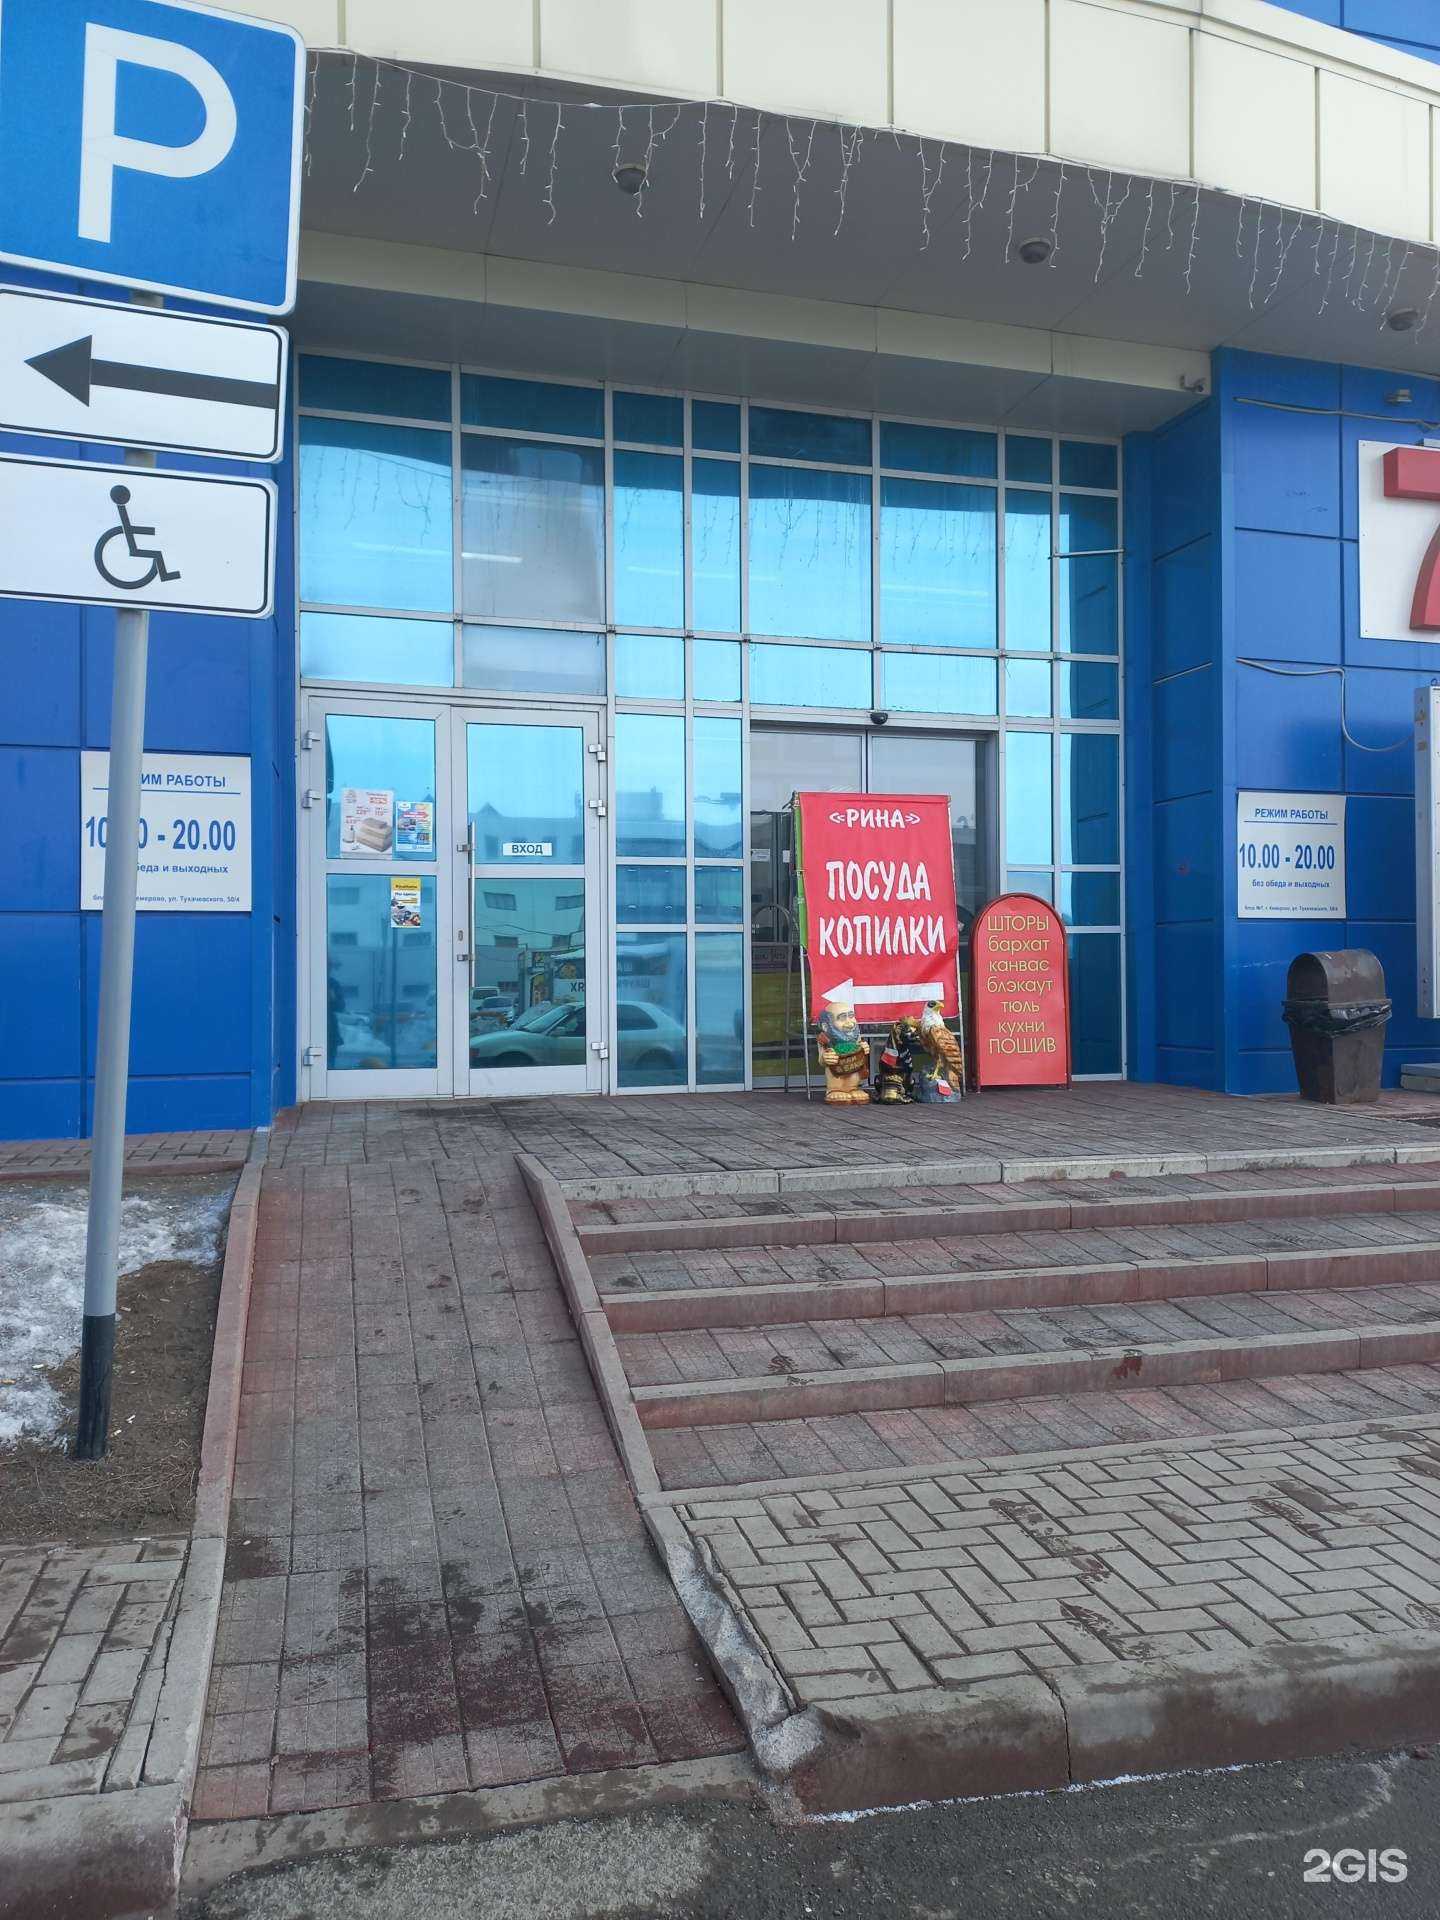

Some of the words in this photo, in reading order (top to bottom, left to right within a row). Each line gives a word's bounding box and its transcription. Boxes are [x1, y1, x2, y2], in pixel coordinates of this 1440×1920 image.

[78, 22, 237, 243] P
[166, 774, 226, 788] РАБОТЫ
[829, 808, 921, 829] «РИНА»
[1254, 808, 1288, 818] РЕЖИМ
[1290, 809, 1329, 820] РАБОТЫ
[172, 818, 236, 851] 20.00
[511, 844, 543, 855] ВХОД
[1239, 843, 1280, 869] 10.00
[1295, 844, 1335, 870] 20.00
[162, 864, 169, 873] и
[172, 864, 228, 875] выходных
[825, 860, 932, 901] ПОСУДА
[1252, 878, 1264, 888] без
[1265, 879, 1287, 888] обеда
[987, 915, 1049, 932] ШТОРЫ
[819, 915, 946, 958] КОПИЛКИ
[988, 935, 1050, 955] бархат
[989, 959, 1049, 972] канвас
[986, 976, 1053, 995] блэкаут
[1001, 1000, 1040, 1013] тюль
[998, 1021, 1045, 1037] кухни
[989, 1037, 1057, 1054] ПОШИВ
